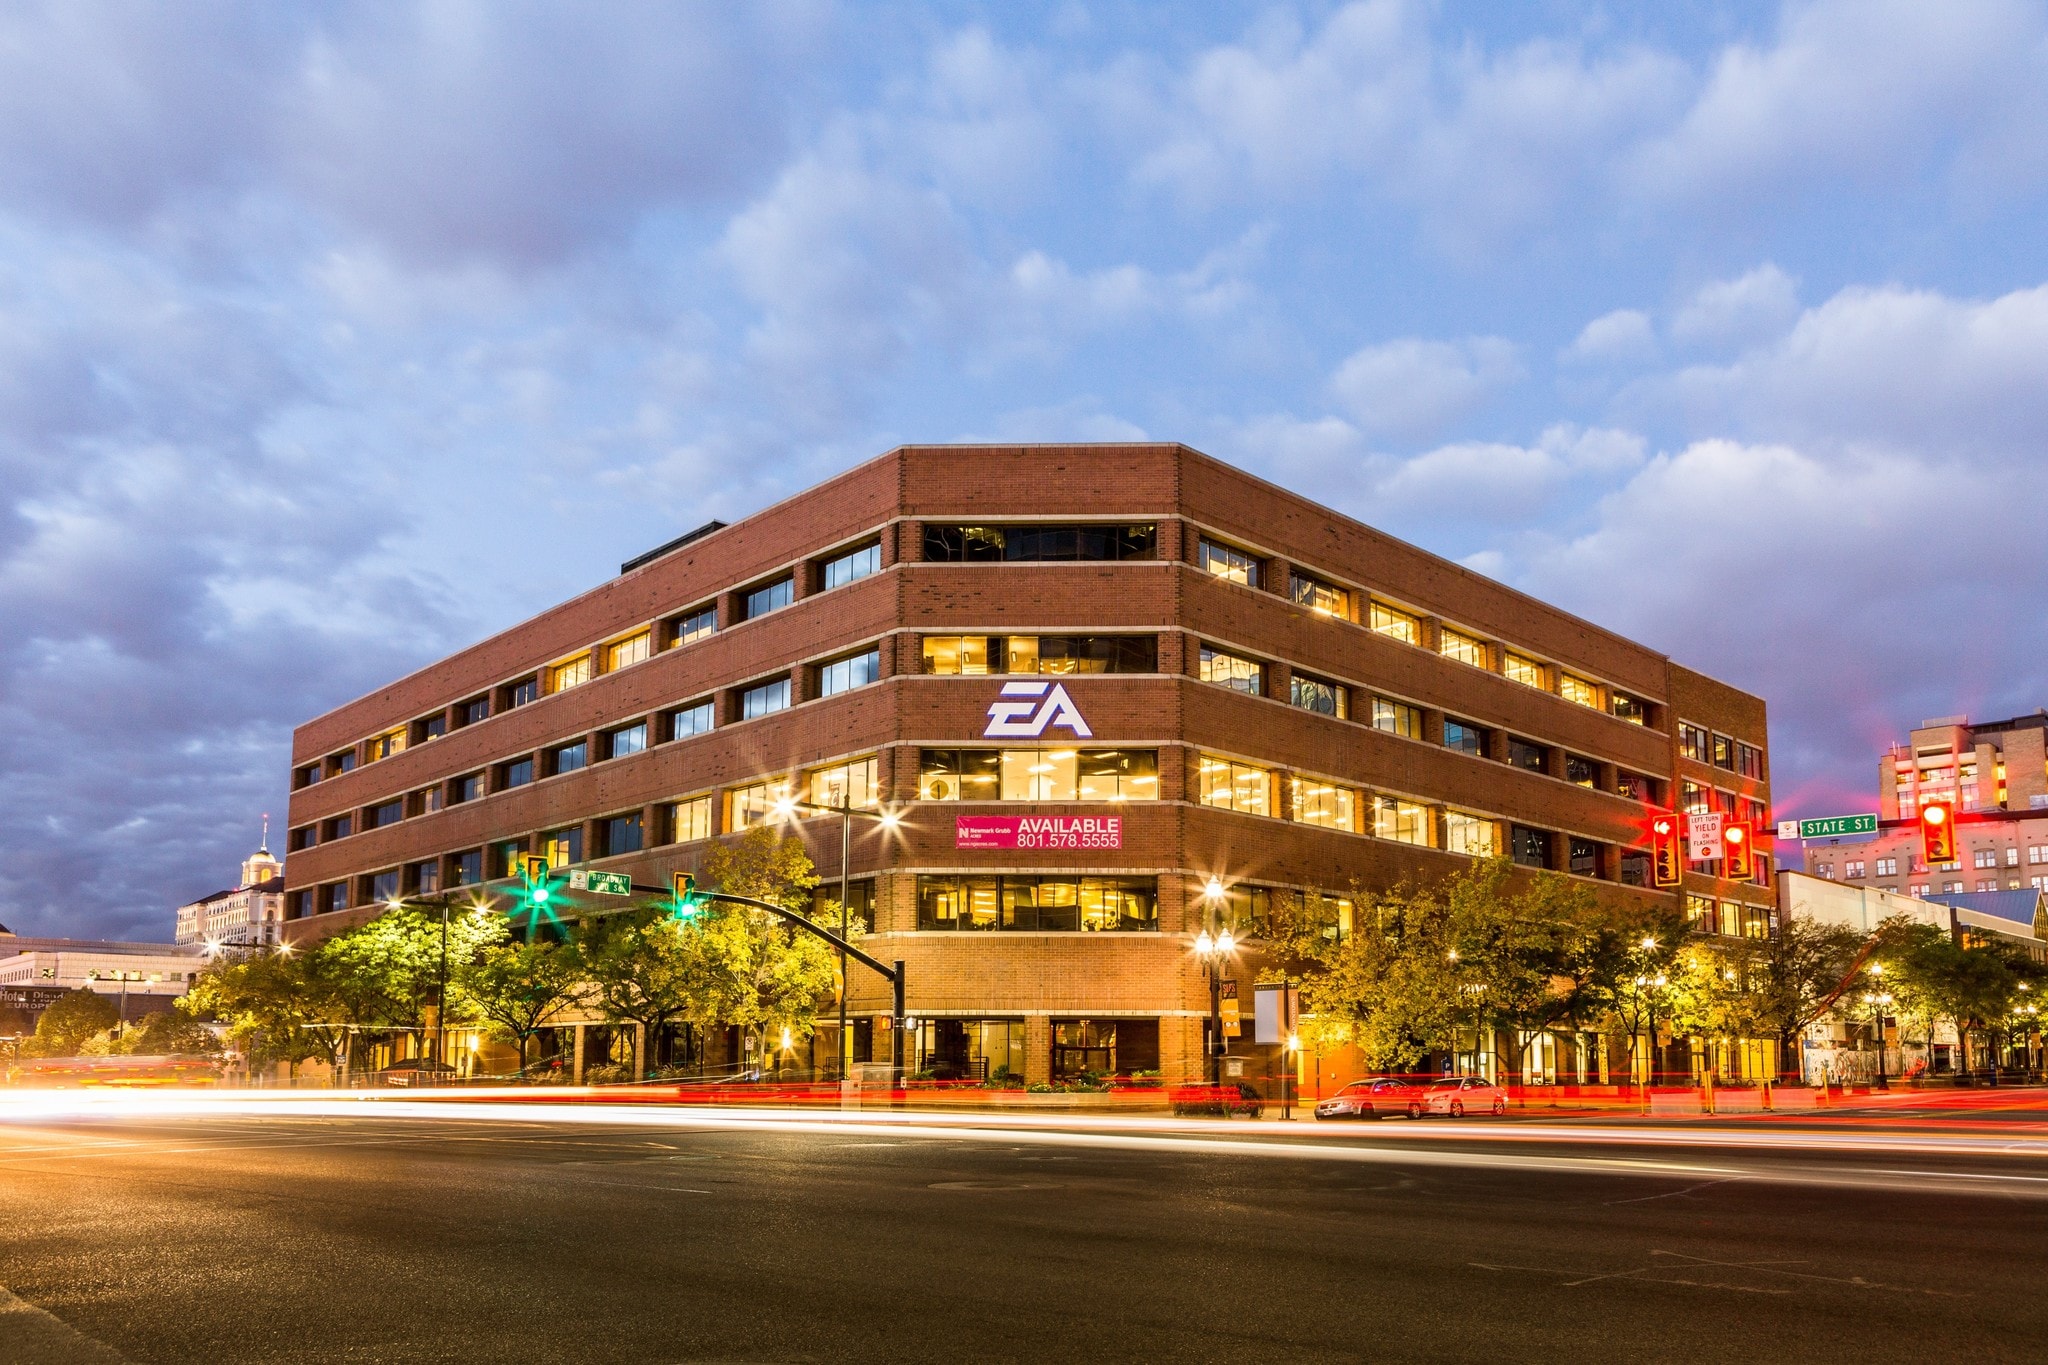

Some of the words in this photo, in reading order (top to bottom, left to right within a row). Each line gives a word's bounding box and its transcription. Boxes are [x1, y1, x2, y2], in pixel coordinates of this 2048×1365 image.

[983, 681, 1093, 738] EA
[1017, 818, 1119, 833] AVAILABLE
[1695, 822, 1717, 832] YIELD
[1807, 820, 1846, 834] STATE
[1854, 818, 1873, 830] ST.
[1017, 833, 1119, 848] 801.578.5555
[1693, 838, 1719, 847] FLASHING
[592, 873, 628, 884] BROADWAY
[0, 990, 26, 1002] Hotel
